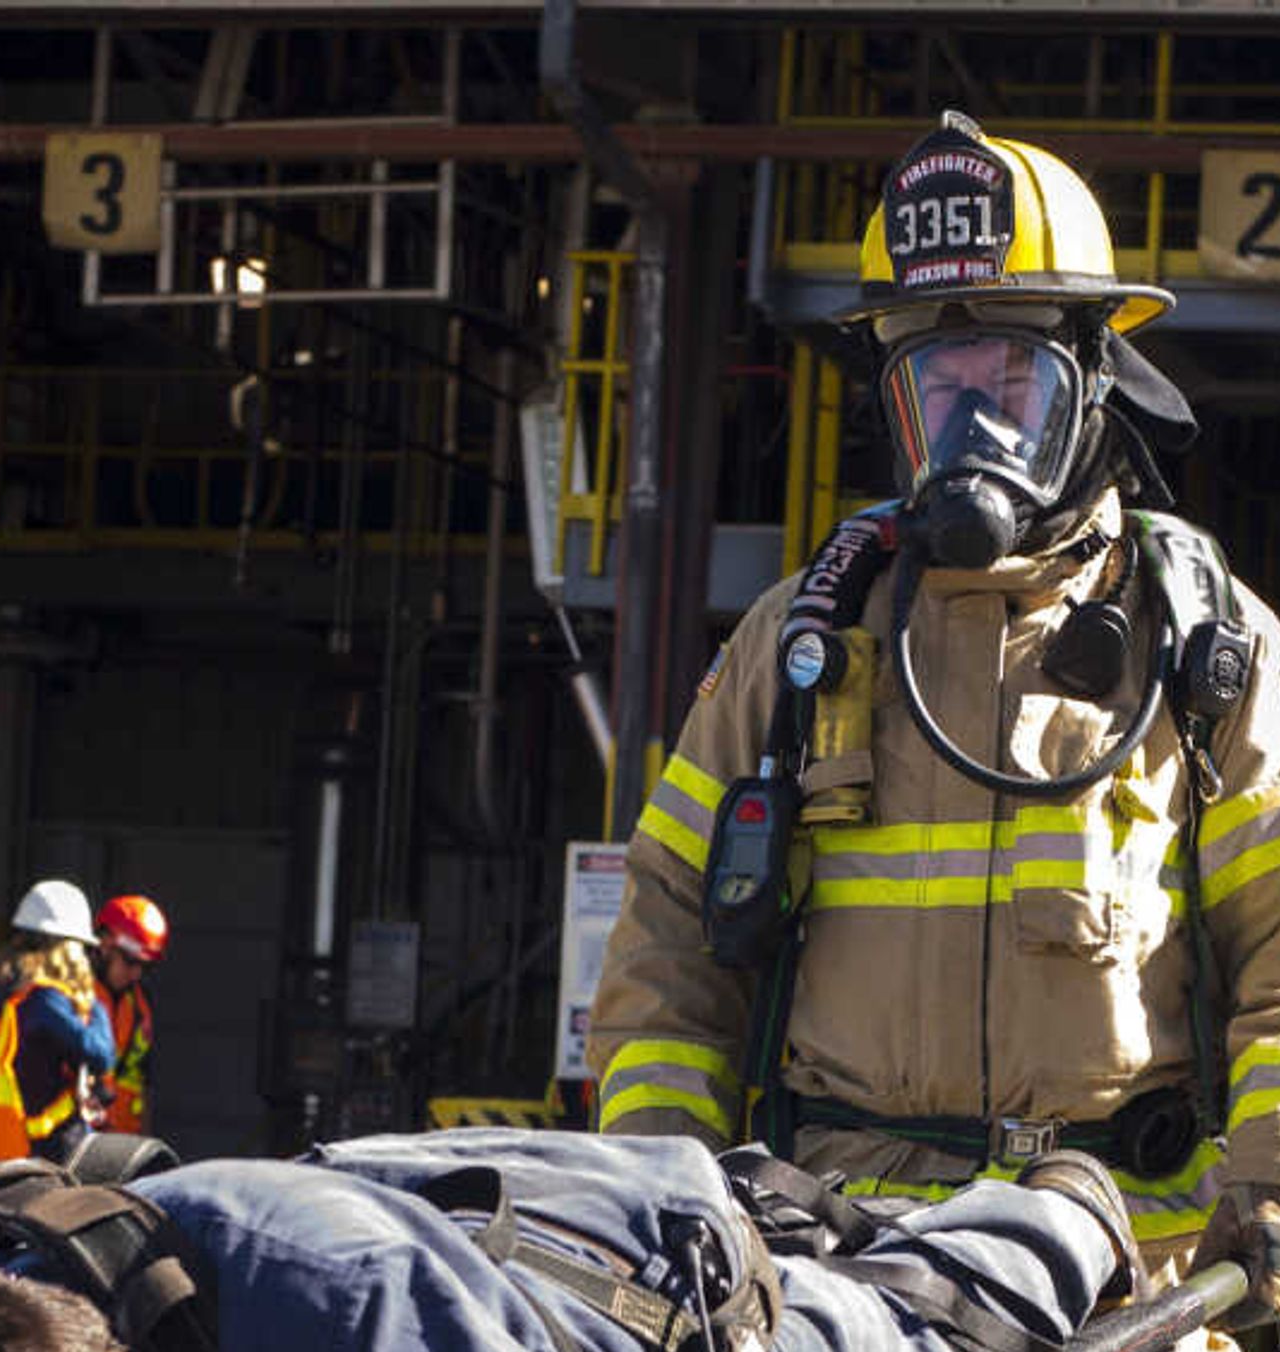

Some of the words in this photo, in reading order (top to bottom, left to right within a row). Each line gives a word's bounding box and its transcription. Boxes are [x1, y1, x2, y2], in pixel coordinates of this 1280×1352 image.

[80, 153, 125, 236] 3
[900, 153, 995, 190] FIREFIGHTER
[891, 195, 996, 254] 3351
